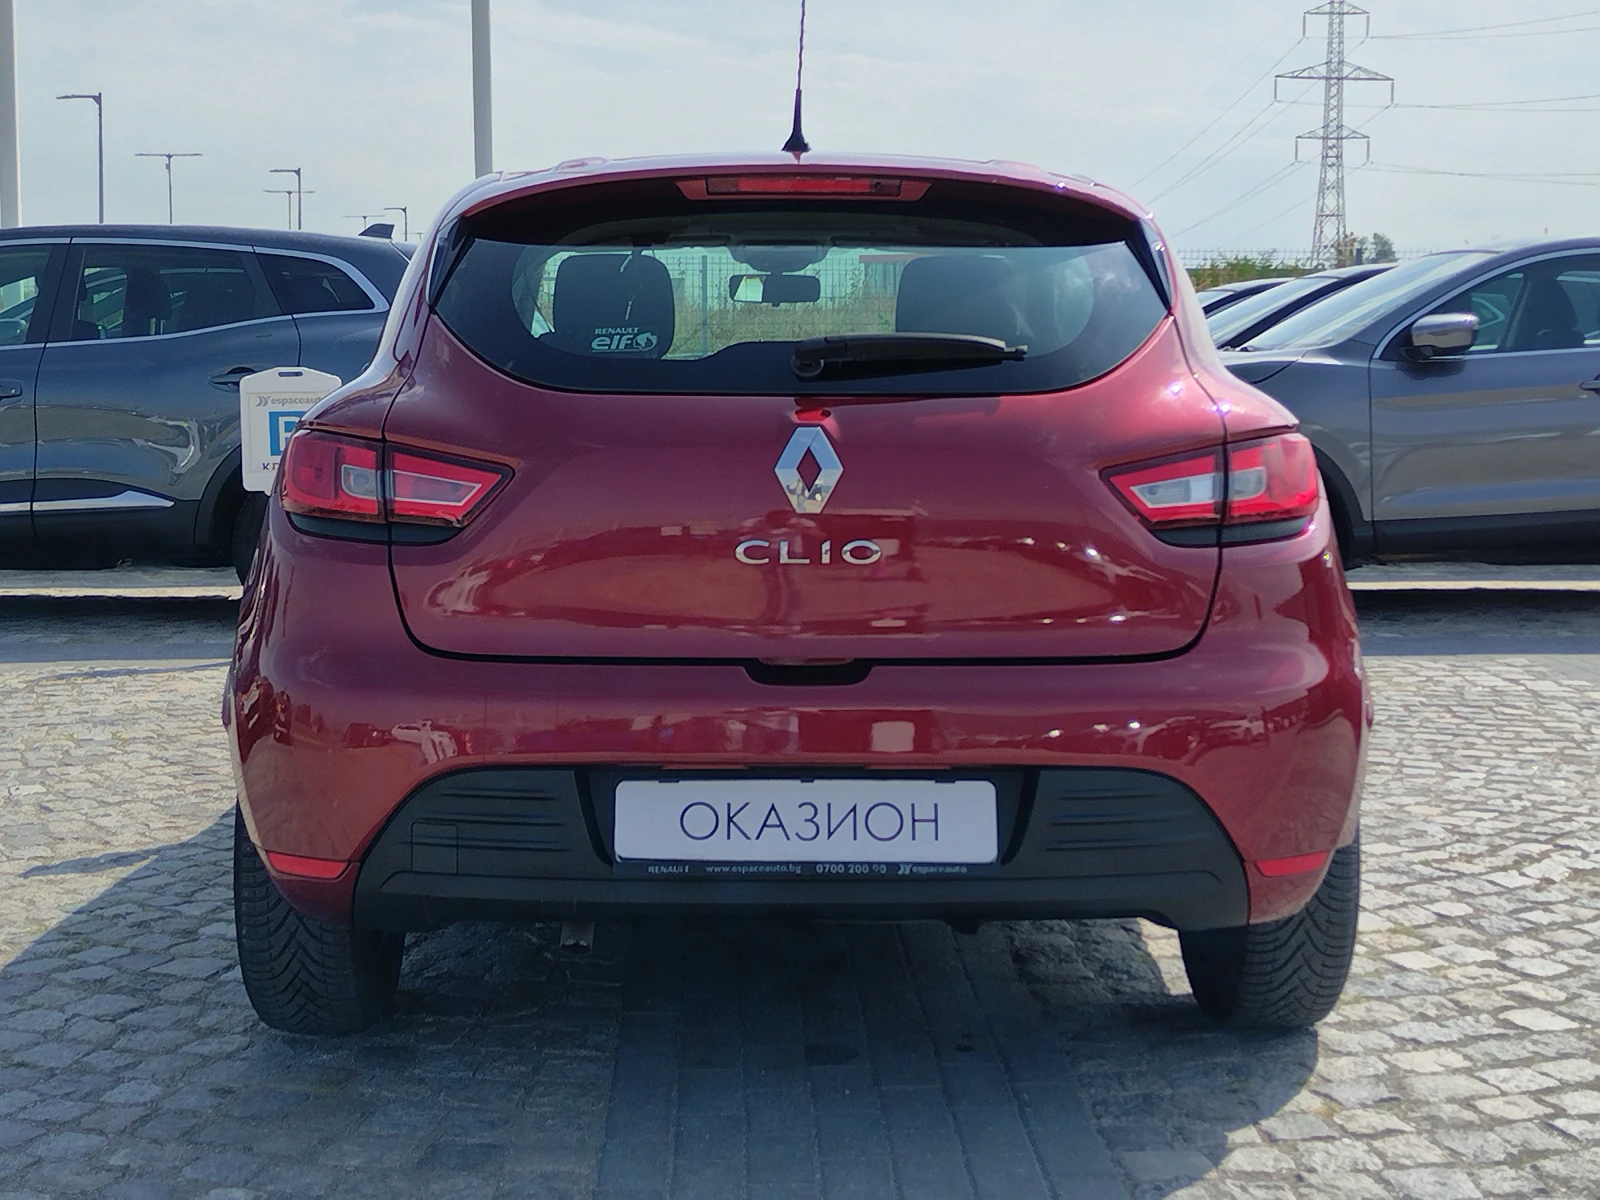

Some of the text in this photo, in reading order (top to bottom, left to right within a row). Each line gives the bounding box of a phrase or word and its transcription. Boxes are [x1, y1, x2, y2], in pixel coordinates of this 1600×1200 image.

[594, 327, 639, 335] RENAULT
[591, 334, 633, 350] elf
[270, 396, 322, 407] espaceaut
[734, 539, 882, 565] CLIO
[679, 801, 939, 842] ОКАЗИОН
[816, 864, 845, 874] 0700
[849, 864, 869, 874] 200
